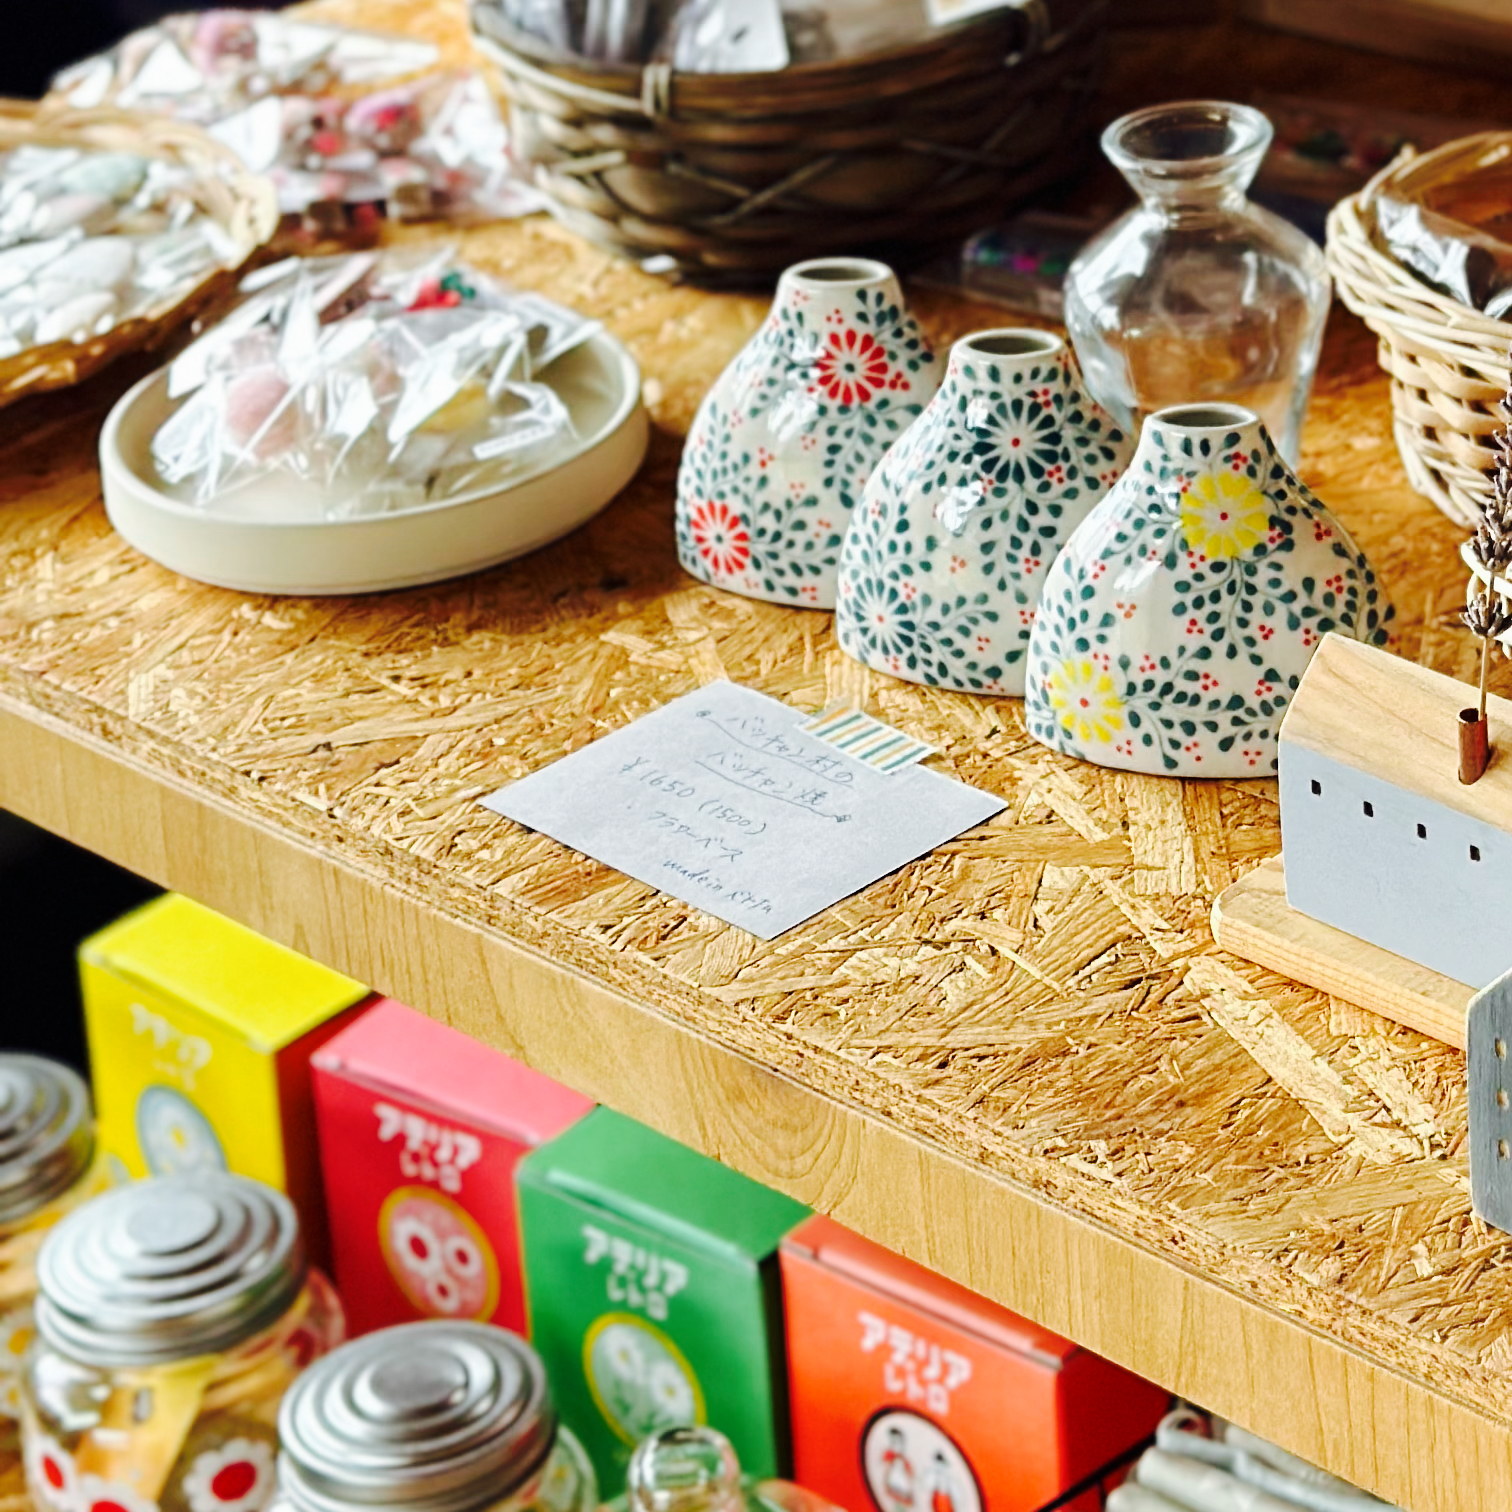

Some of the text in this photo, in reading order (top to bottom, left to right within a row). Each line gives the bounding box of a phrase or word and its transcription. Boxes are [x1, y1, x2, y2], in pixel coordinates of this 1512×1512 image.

[372, 1101, 483, 1172] アデリア
[581, 1224, 690, 1298] アデリア
[857, 1310, 972, 1392] アデリア
